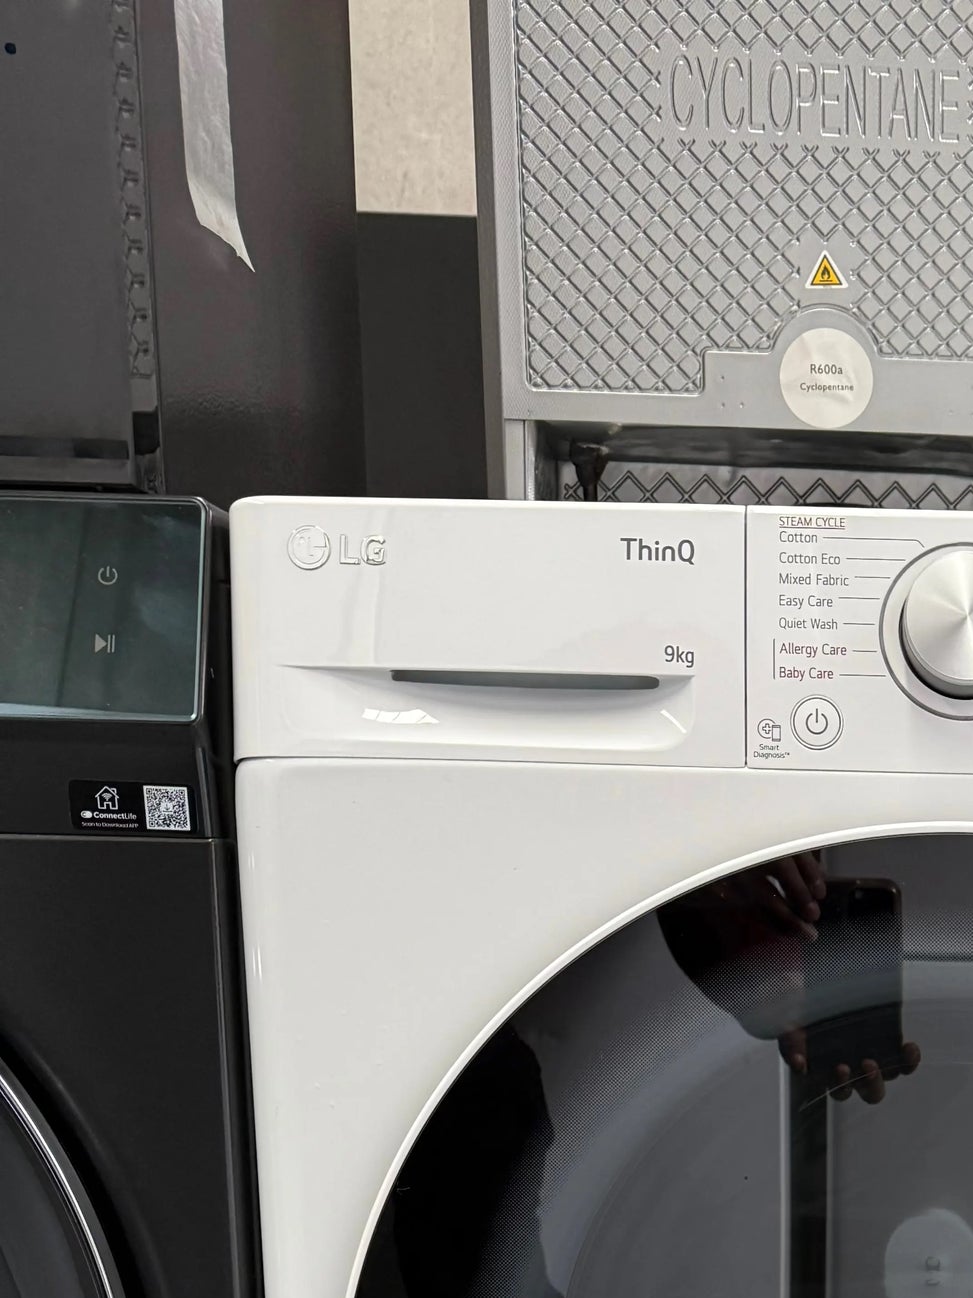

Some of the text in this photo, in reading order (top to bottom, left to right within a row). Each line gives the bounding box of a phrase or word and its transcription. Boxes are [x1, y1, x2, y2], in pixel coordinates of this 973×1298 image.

[667, 54, 962, 144] CYCLOPENTANE
[810, 363, 843, 375] R600a
[800, 382, 854, 392] Cyclopentane
[779, 516, 845, 528] STEAM CYCLE
[779, 531, 818, 543] Cotton
[340, 534, 386, 566] LG
[620, 538, 695, 565] ThinQ
[779, 552, 841, 565] Cotton Eco
[779, 573, 849, 586] Mixed Fabric
[778, 594, 833, 609] Easy Care
[778, 617, 838, 630] Quiet Wash
[664, 645, 694, 668] 9kg
[779, 643, 847, 658] Allergy Care
[779, 666, 834, 681] Baby Care
[93, 811, 137, 820] ConnectLife
